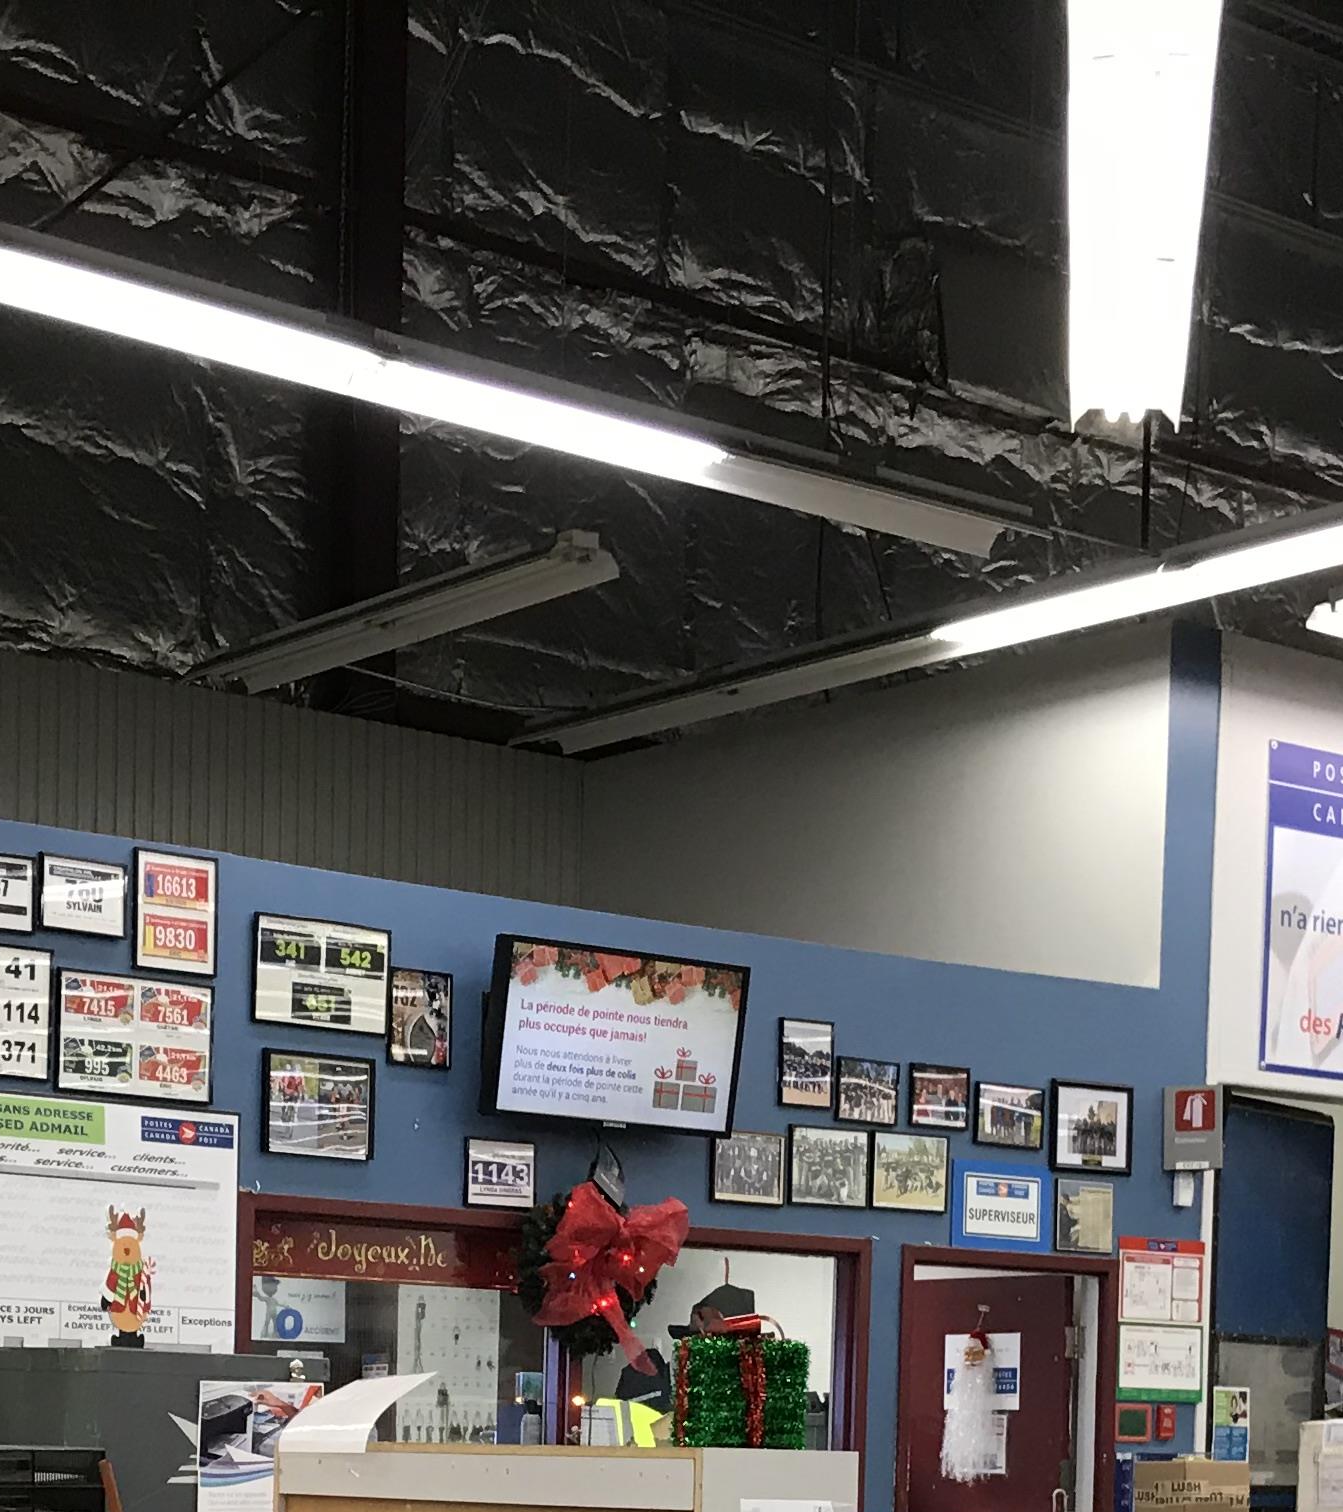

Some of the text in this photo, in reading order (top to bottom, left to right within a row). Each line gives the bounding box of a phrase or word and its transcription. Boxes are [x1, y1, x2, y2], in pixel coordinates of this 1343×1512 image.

[156, 874, 196, 899] 16613
[66, 900, 103, 914] SYLVAIN
[155, 926, 196, 950] 9830
[274, 939, 305, 960] 341
[339, 947, 372, 969] 542
[4, 956, 36, 981] 41
[3, 1000, 40, 1025] 114
[82, 998, 116, 1017] 7415
[157, 1006, 190, 1025] 7561
[520, 998, 689, 1030] La période de pointe nous tiendra
[518, 1017, 648, 1043] plus occupés que jamais!
[1299, 1008, 1332, 1036] des
[1, 1039, 36, 1064] 371
[516, 1044, 538, 1057] Nous
[539, 1047, 561, 1059] nous
[562, 1050, 604, 1064] attendons
[84, 1059, 110, 1075] 995
[155, 1064, 188, 1083] 4463
[514, 1059, 637, 1081] plus de deux fois plus de colis
[512, 1085, 538, 1097] année
[513, 1071, 540, 1083] durant
[551, 1075, 583, 1089] période
[584, 1079, 595, 1089] de
[596, 1081, 621, 1093] pointe
[34, 1107, 94, 1121] ADRESSE
[29, 1121, 88, 1137] ADMAIL
[473, 1162, 529, 1186] 1143
[968, 1207, 1036, 1225] SUPERVISEUR
[317, 1228, 409, 1274] Joyeux
[14, 1305, 21, 1313] 3
[23, 1306, 56, 1315] JOURS
[78, 1313, 103, 1321] JOURS
[16, 1315, 43, 1325] LEFT
[71, 1321, 94, 1330] DAYS
[153, 1325, 174, 1334] LEFT
[181, 1316, 233, 1329] Exceptions
[1171, 1481, 1202, 1493] LUSH
